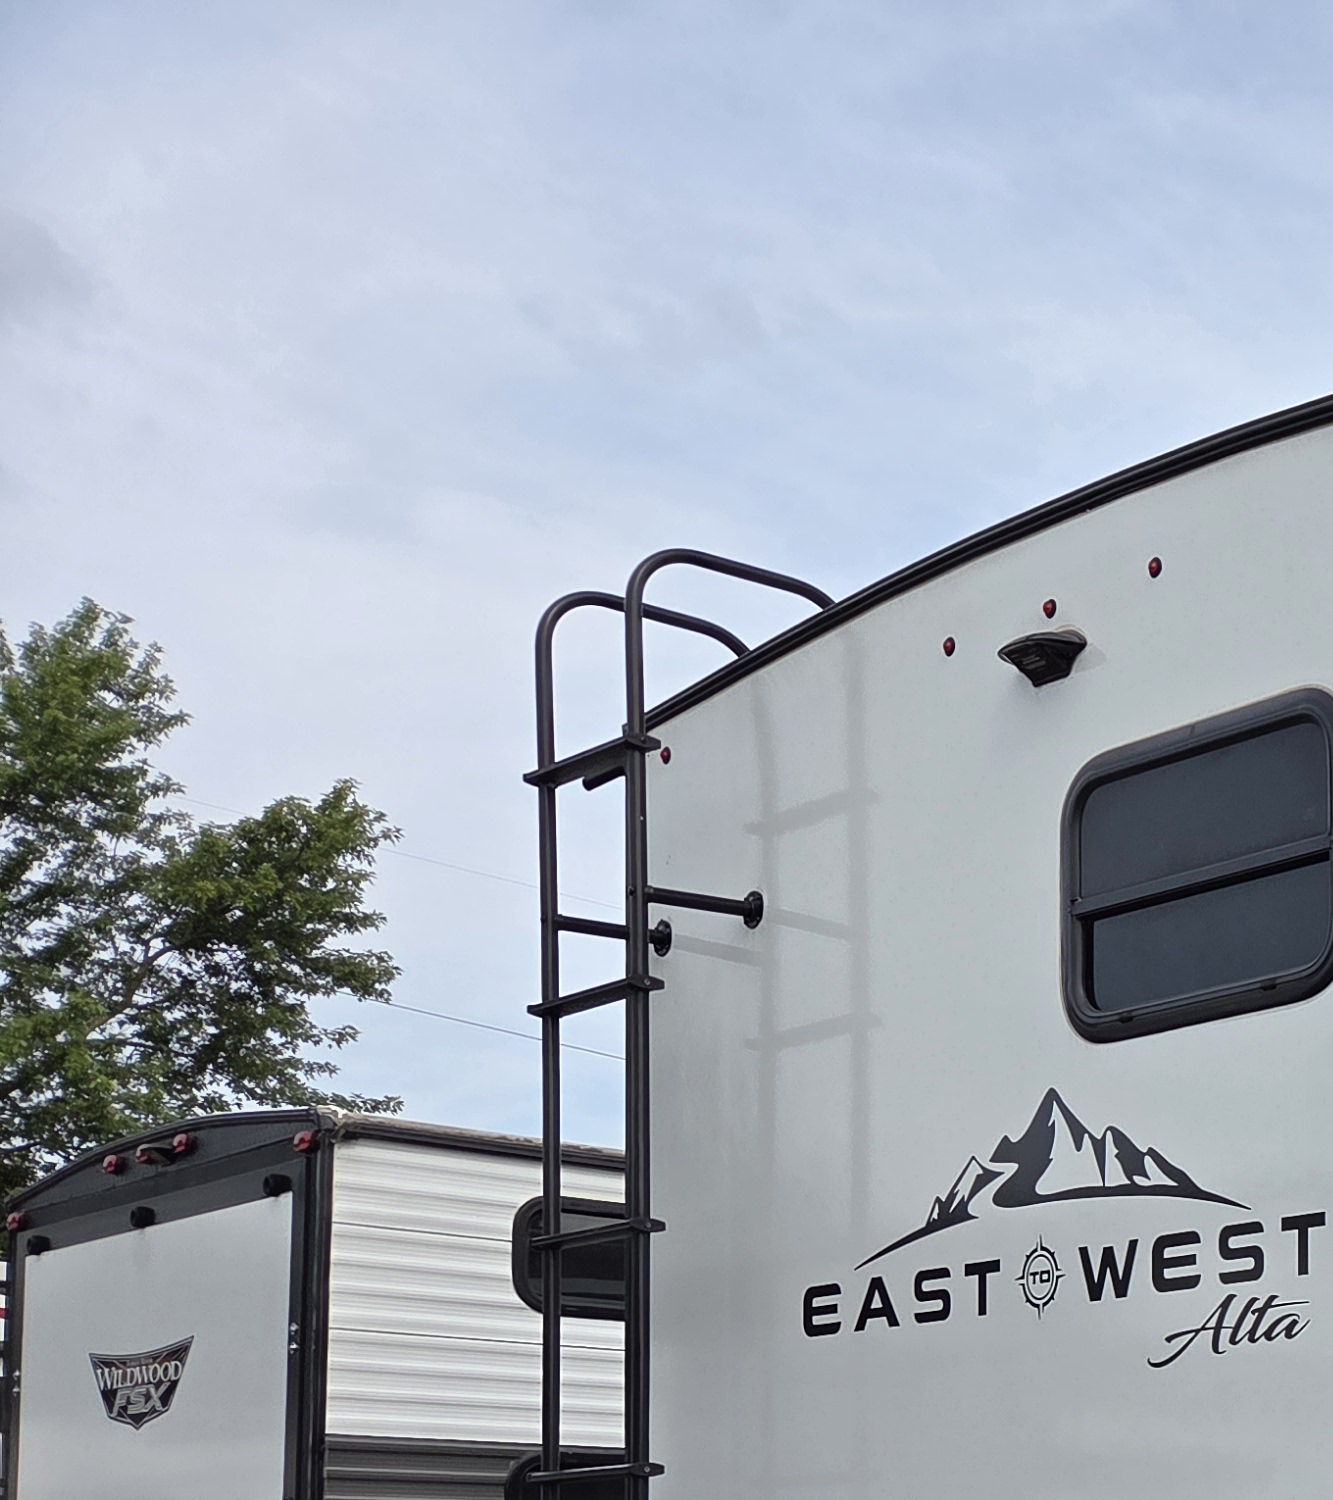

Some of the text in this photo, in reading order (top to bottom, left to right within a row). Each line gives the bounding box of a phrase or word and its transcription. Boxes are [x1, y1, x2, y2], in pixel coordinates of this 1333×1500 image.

[803, 1211, 1326, 1338] EAST TO WEST
[1147, 1293, 1311, 1369] Alta
[96, 1360, 182, 1392] WILDWOOD
[112, 1382, 171, 1417] FSX
